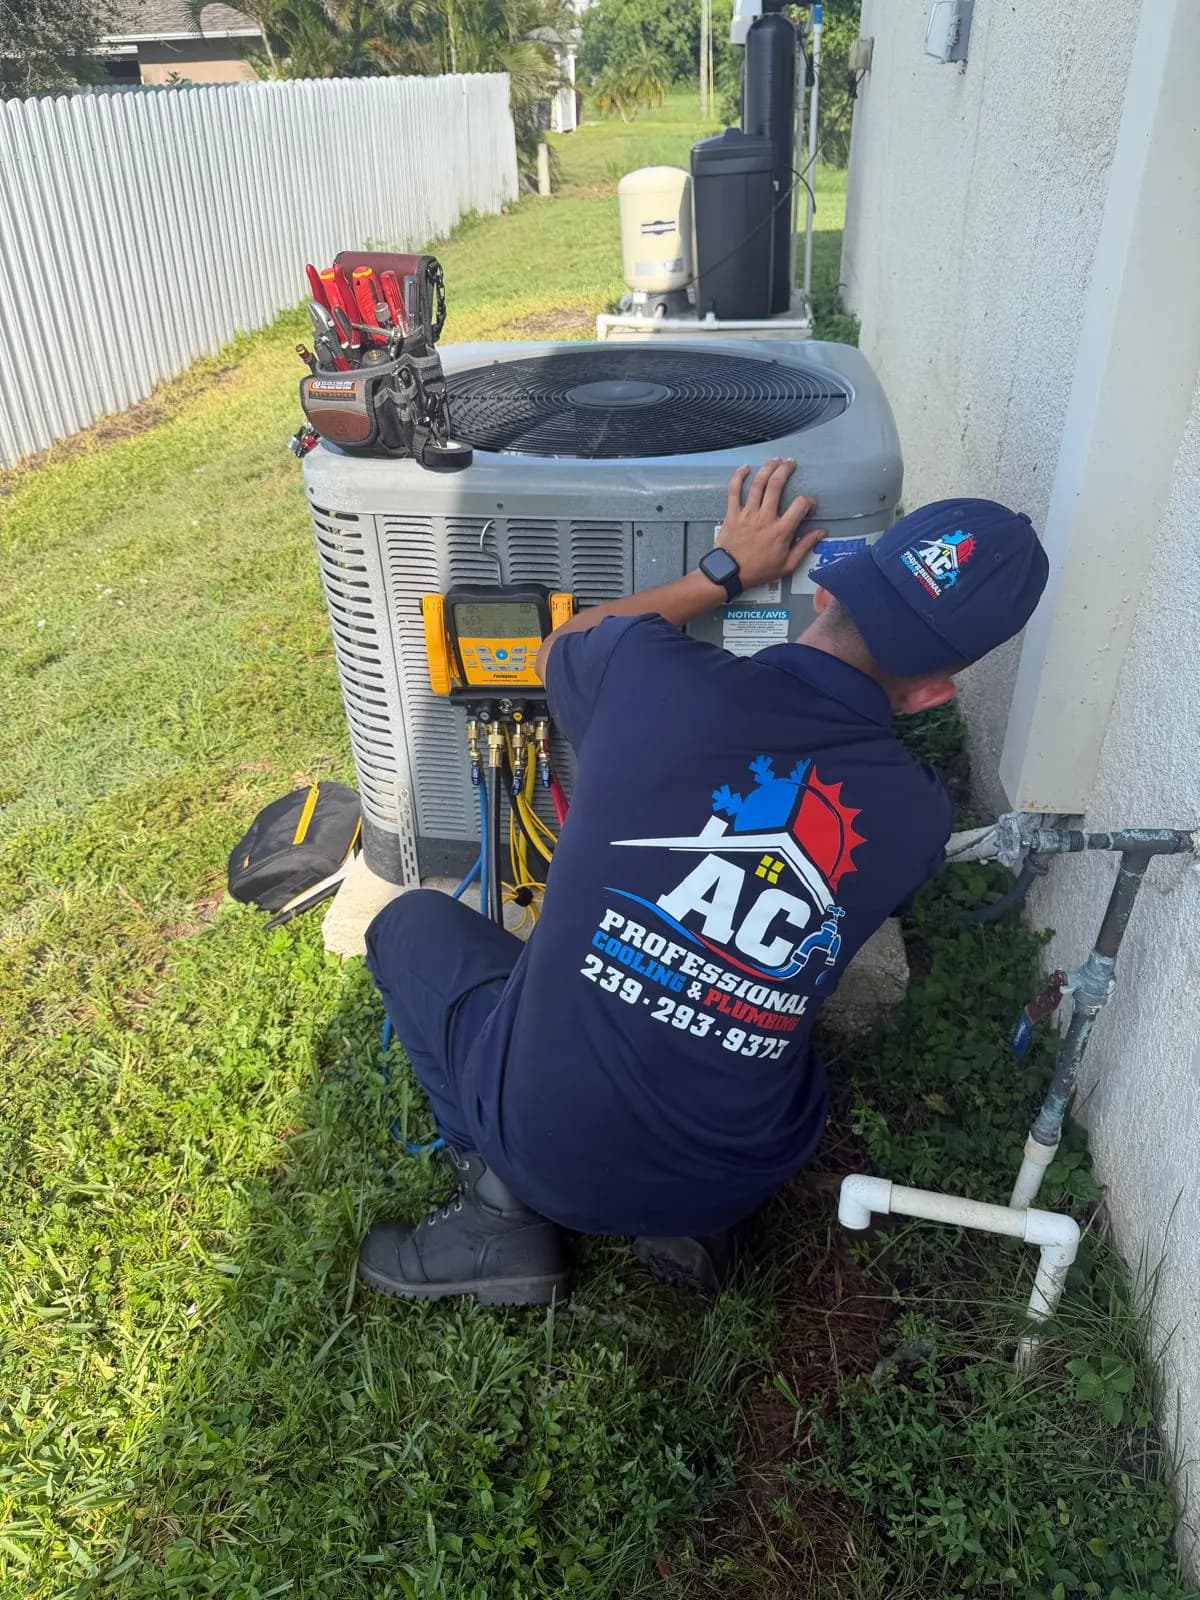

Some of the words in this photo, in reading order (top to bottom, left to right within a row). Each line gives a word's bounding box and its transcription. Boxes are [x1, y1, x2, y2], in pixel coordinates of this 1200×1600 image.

[919, 545, 952, 575] AC
[727, 610, 787, 619] NOTICE/AVIS
[656, 853, 811, 966] AC
[591, 930, 687, 993] COOLING
[686, 981, 704, 1001] &
[704, 990, 801, 1032] PLUMBING
[599, 908, 809, 1016] PROFESSIONAL
